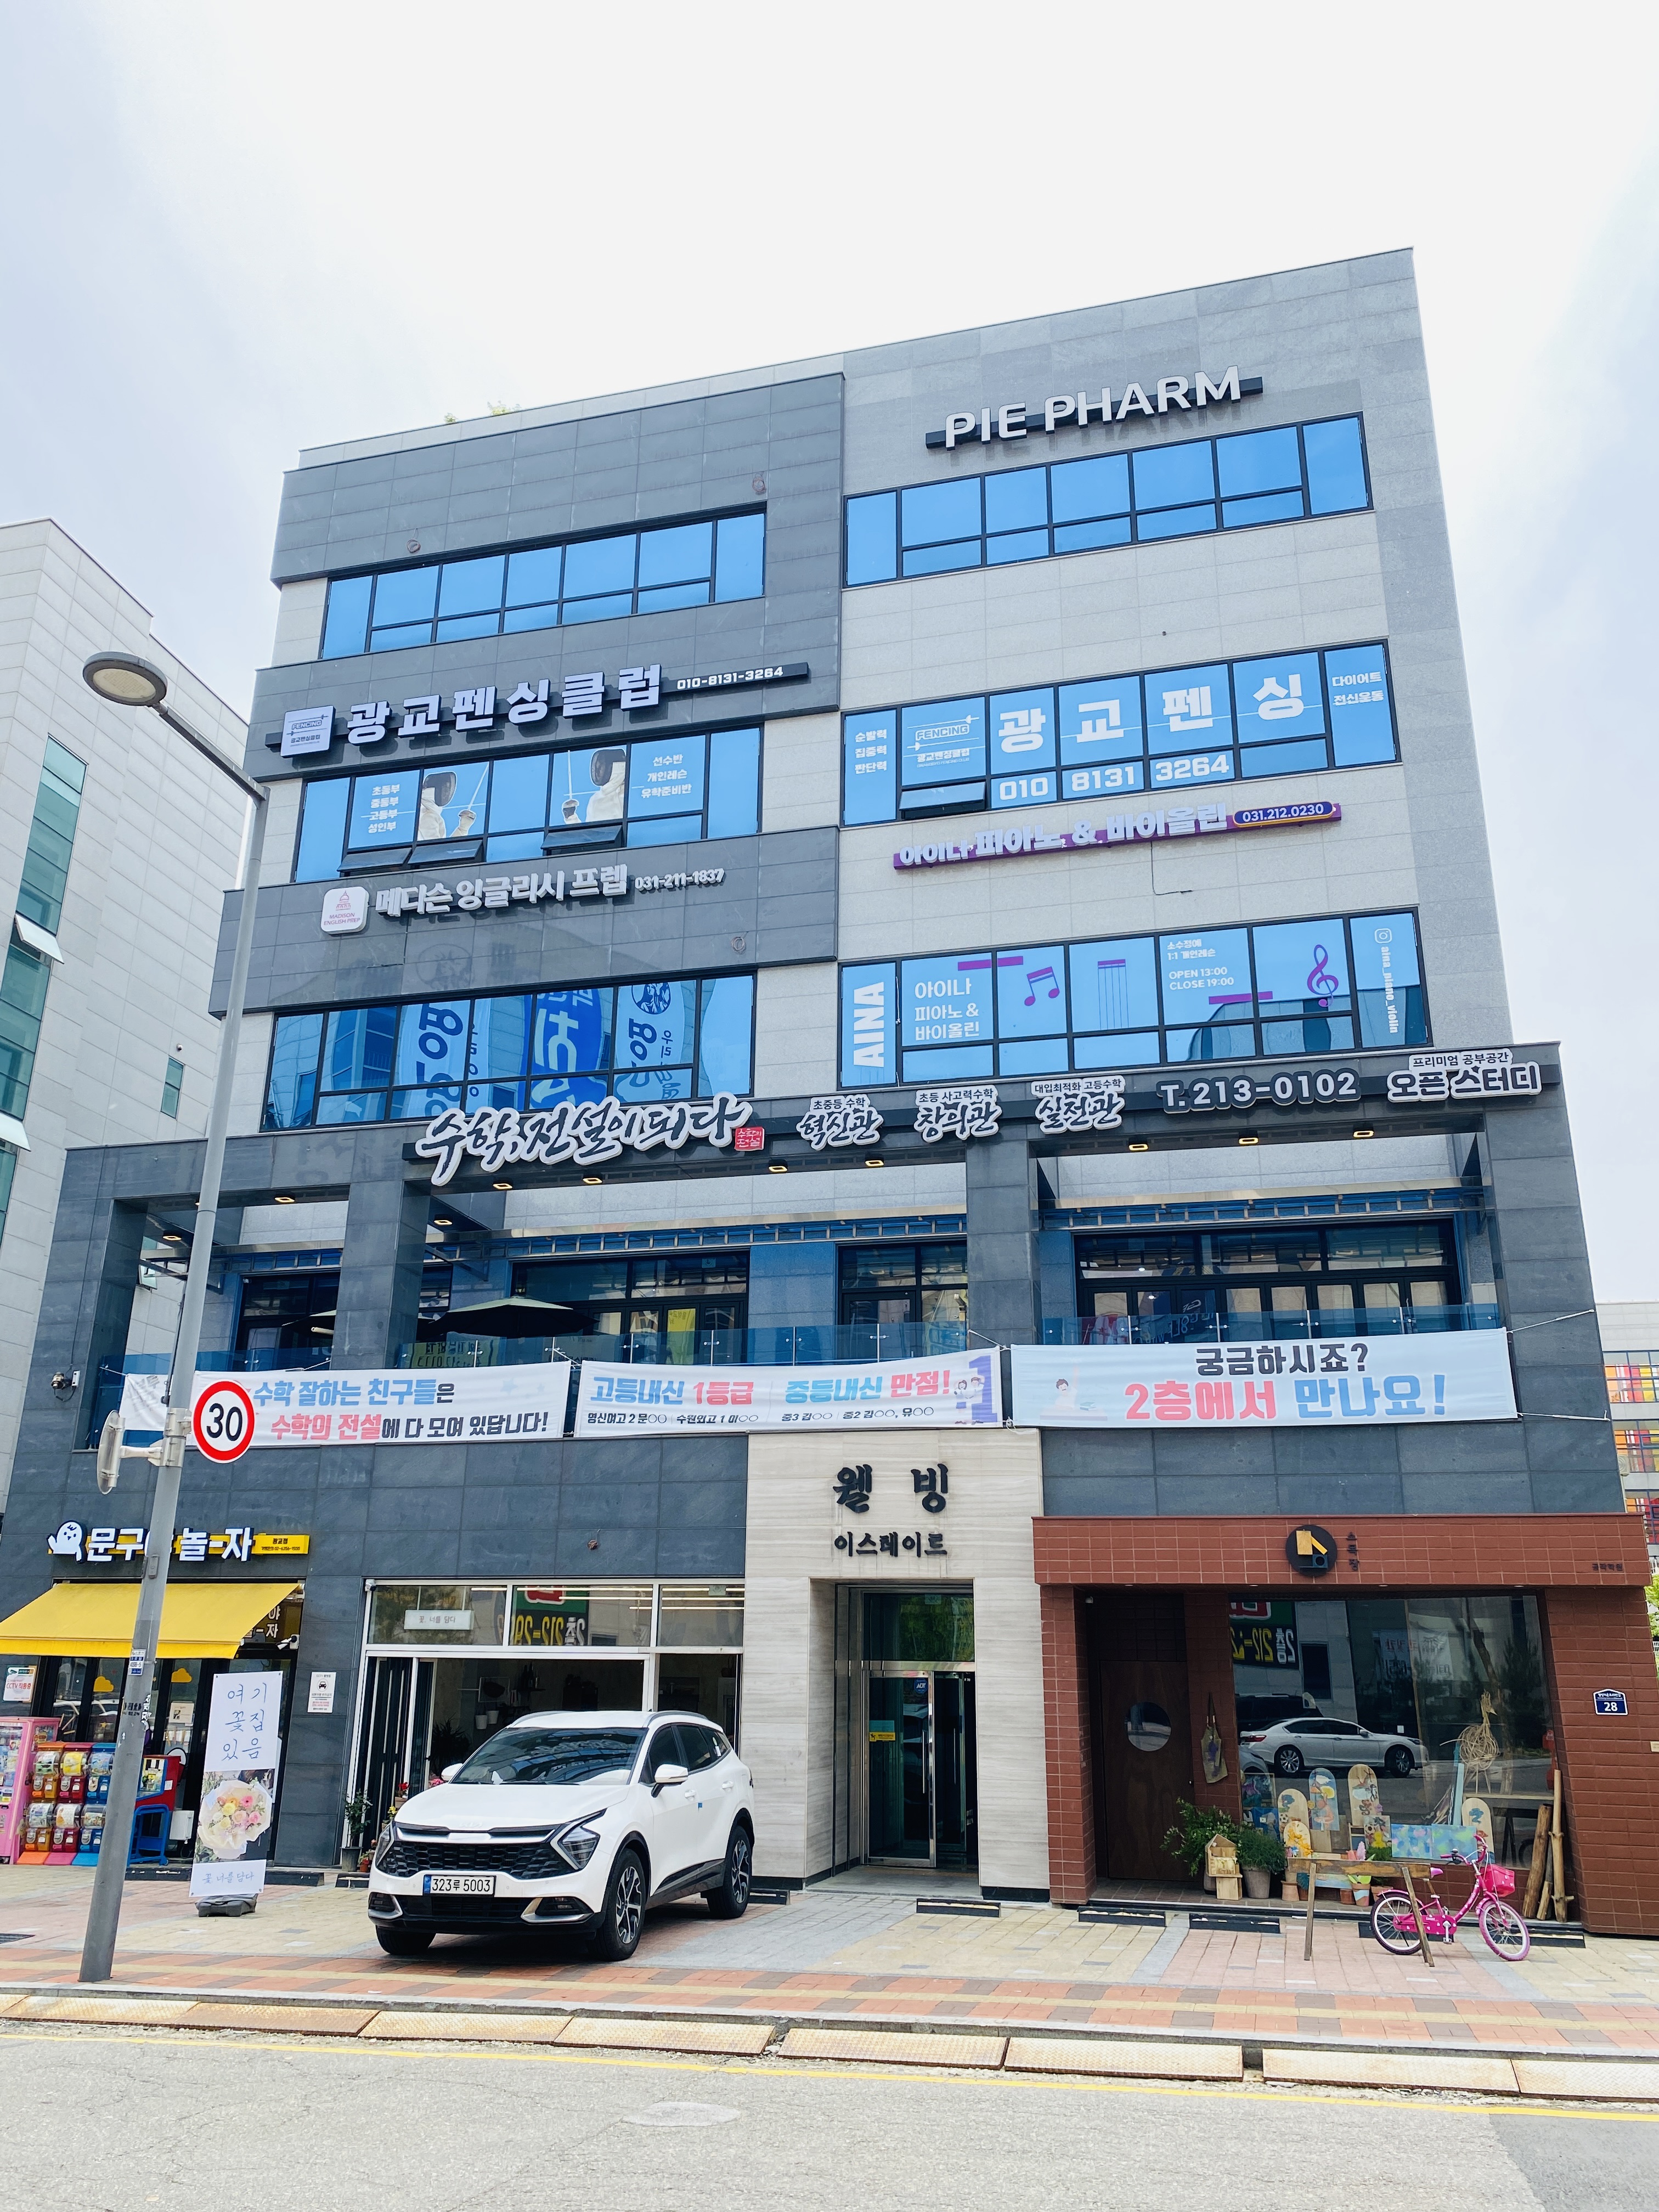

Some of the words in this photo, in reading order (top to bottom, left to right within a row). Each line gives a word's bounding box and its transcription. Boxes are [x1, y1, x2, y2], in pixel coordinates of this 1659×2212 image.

[945, 402, 1026, 448] PIE
[1045, 365, 1241, 432] PHARM
[676, 665, 785, 690] 010-8131-3264
[1331, 671, 1383, 687] 다이어트
[347, 664, 661, 744] 광교펜싱클럽
[1333, 690, 1384, 706] 전신운동
[292, 720, 322, 729] FENCING
[917, 725, 968, 740] FENCING
[855, 729, 887, 743] 순발력
[855, 745, 887, 759] 집중력
[917, 748, 970, 763] 광교펜싱클럽
[653, 754, 684, 767] 선수반
[854, 761, 887, 775] 판단력
[647, 769, 687, 782] 개인레슨
[999, 777, 1048, 801] 010
[1071, 766, 1135, 790] 8131
[1154, 757, 1230, 781] 3264
[372, 784, 400, 796] 초등부
[641, 784, 692, 799] 유학준비반
[371, 797, 399, 809] 중등부
[369, 809, 398, 821] 고등부
[1242, 802, 1325, 823] 031.212.0230
[368, 821, 396, 833] 성인부
[900, 842, 972, 867] 아이나
[974, 825, 1062, 857] 피아노
[1072, 821, 1098, 845] &
[1106, 803, 1227, 842] 바이올린
[634, 868, 725, 891] 031-211-1837
[375, 882, 453, 917] 메디슨
[456, 870, 565, 911] 잉글리시
[569, 864, 627, 897] 프렙
[1167, 939, 1202, 950] 소수정예
[1167, 952, 1178, 960] 1:1
[1181, 949, 1216, 960] 개인레슨
[1169, 969, 1198, 980] OPEN
[1200, 967, 1228, 977] 13:00
[915, 978, 972, 999] 아이나
[1170, 979, 1205, 990] CLOSE
[1207, 977, 1234, 987] 19:00
[915, 1004, 961, 1022] 피아노
[966, 1003, 979, 1017] &
[854, 982, 885, 1068] AINA
[915, 1022, 980, 1042] 바이올린
[1413, 1054, 1459, 1068] 프리미엄
[1463, 1052, 1510, 1065] 공부공간
[1035, 1083, 1081, 1094] 대입최적화
[1084, 1079, 1122, 1090] 고등수학
[814, 1099, 842, 1110] 초중등
[845, 1097, 865, 1108] 수학
[919, 1092, 939, 1103] 초등
[941, 1088, 994, 1101] 사고력수학
[1039, 1093, 1124, 1129] 실전관
[527, 1102, 635, 1158] 전설이
[642, 1097, 745, 1143] 되다
[799, 1109, 879, 1146] 혁신관
[919, 1101, 998, 1138] 창의관
[1196, 1342, 1369, 1375] 궁금하시죠?
[254, 1380, 295, 1407] 수학
[298, 1379, 362, 1406] 잘하는
[368, 1379, 455, 1406] 친구들은
[590, 1376, 683, 1404] 고등내신
[692, 1381, 754, 1406] 1등급
[785, 1375, 884, 1404] 중등내신
[890, 1369, 951, 1398] 만점!
[1125, 1379, 1277, 1420] 2층에서
[1295, 1374, 1446, 1419] 만나요!
[206, 1402, 243, 1443] 30
[628, 1413, 636, 1423] 2
[676, 1415, 716, 1424] 수원외고
[782, 1413, 799, 1421] 중3
[843, 1410, 860, 1419] 중2
[272, 1413, 331, 1441] 수학의
[337, 1412, 400, 1440] 전설에
[405, 1418, 424, 1438] 다
[427, 1418, 465, 1438] 모여
[469, 1412, 549, 1437] 있답니다!
[87, 1527, 173, 1562] 문구
[834, 1531, 947, 1558] 이스테이트
[430, 1616, 441, 1624] 너를
[444, 1616, 456, 1624] 담다
[228, 1682, 267, 1705] 여기
[1604, 1702, 1618, 1712] 28
[225, 1709, 264, 1732] 꽃집
[222, 1738, 262, 1761] 있음
[463, 1879, 490, 1892] 5003
